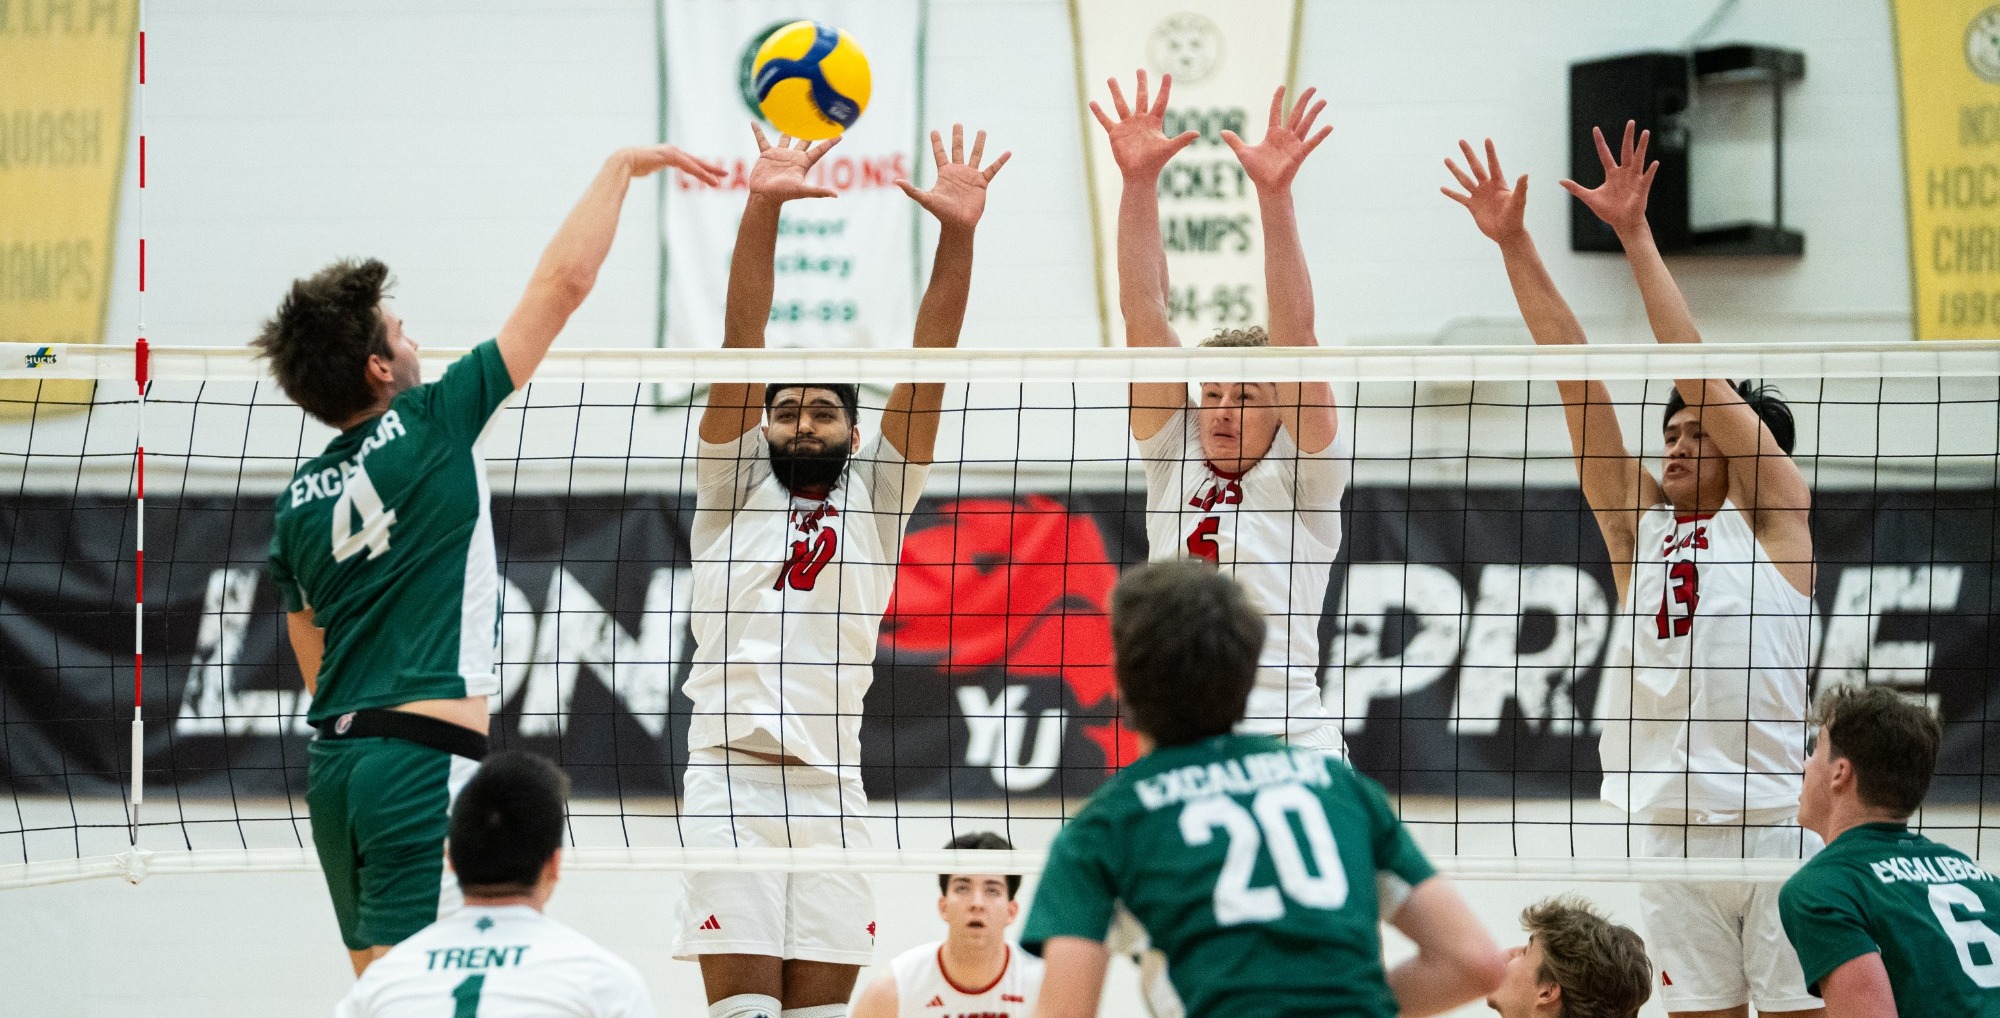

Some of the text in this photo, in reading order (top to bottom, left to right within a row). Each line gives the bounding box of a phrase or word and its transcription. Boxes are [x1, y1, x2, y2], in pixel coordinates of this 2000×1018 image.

[1163, 107, 1248, 147] DOOR
[1162, 213, 1252, 254] AMPS
[331, 465, 398, 563] 4
[1656, 558, 1700, 640] 13
[1321, 562, 1964, 736] PRE
[955, 684, 1068, 791] YU
[1177, 781, 1349, 927] 20
[426, 945, 531, 970] TRENT
[1927, 882, 2000, 989] 6
